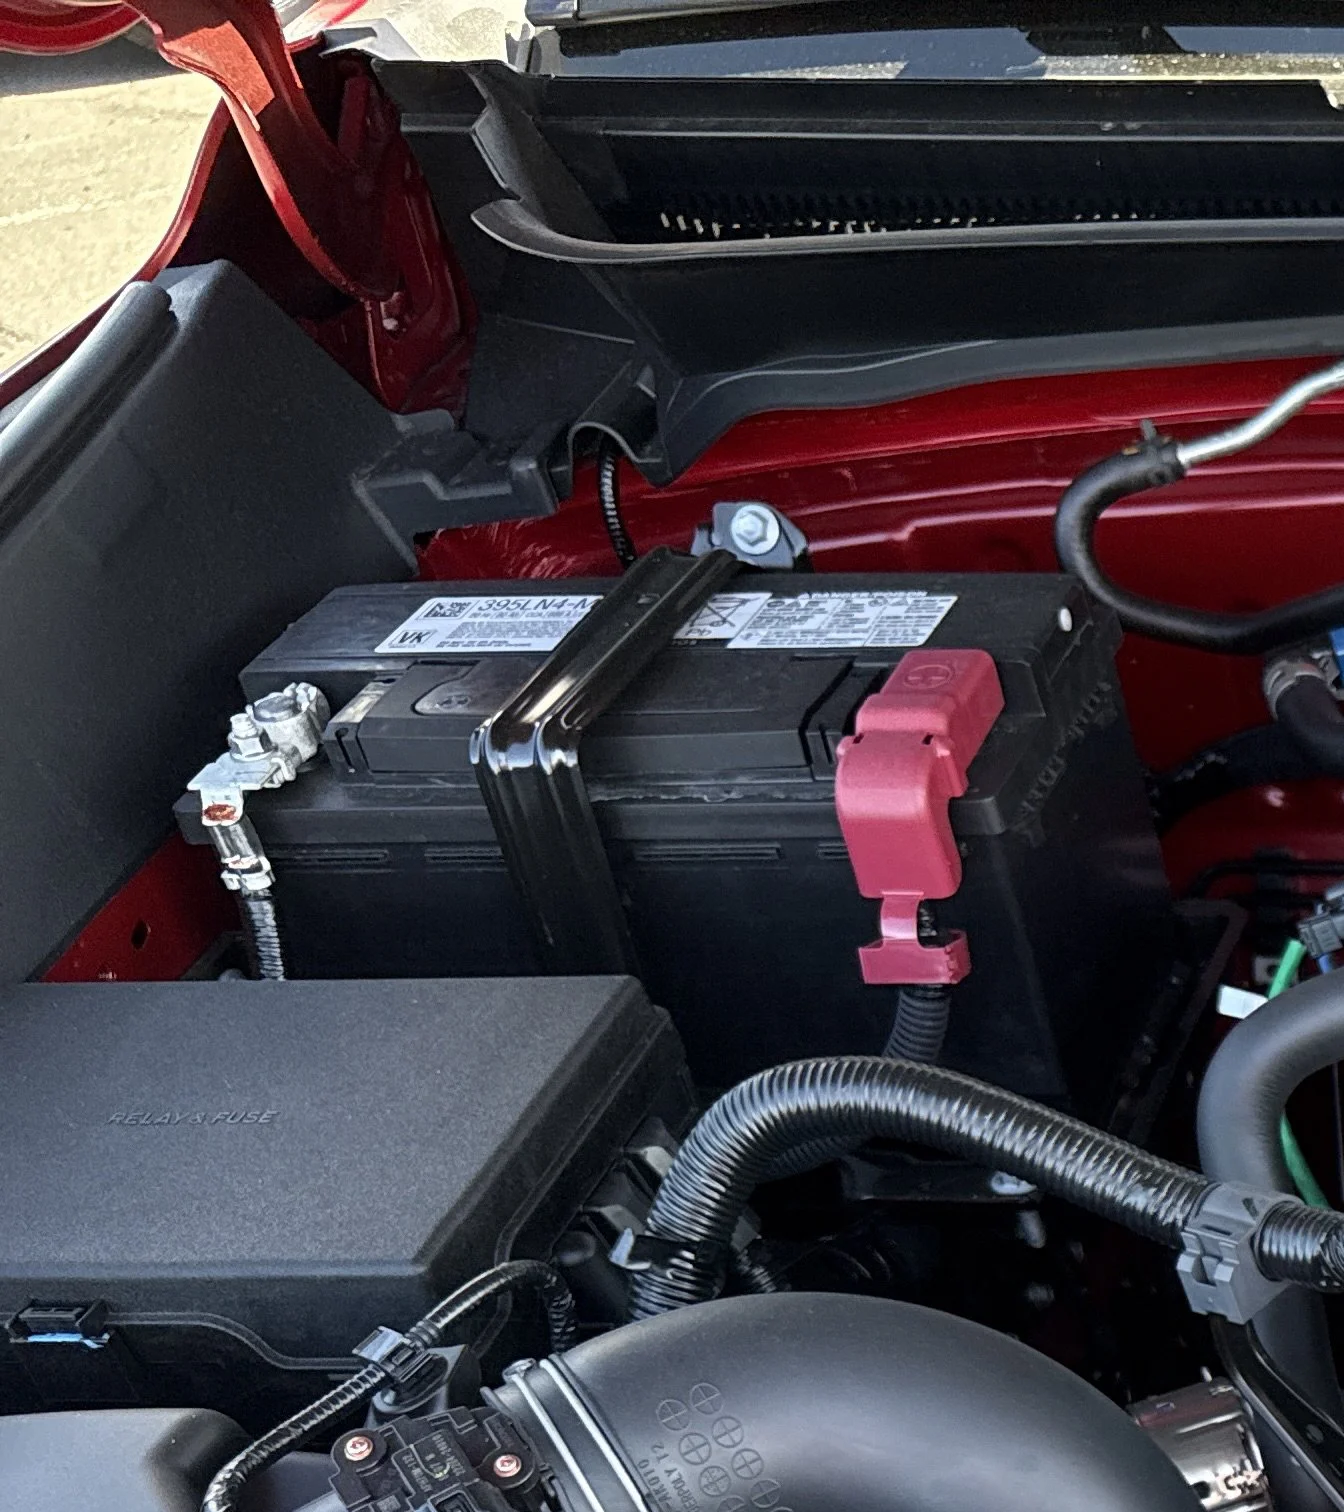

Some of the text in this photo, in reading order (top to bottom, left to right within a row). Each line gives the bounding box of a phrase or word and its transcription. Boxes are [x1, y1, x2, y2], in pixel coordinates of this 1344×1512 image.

[399, 630, 431, 645] VK
[104, 1110, 281, 1126] RELAY & FUSE
